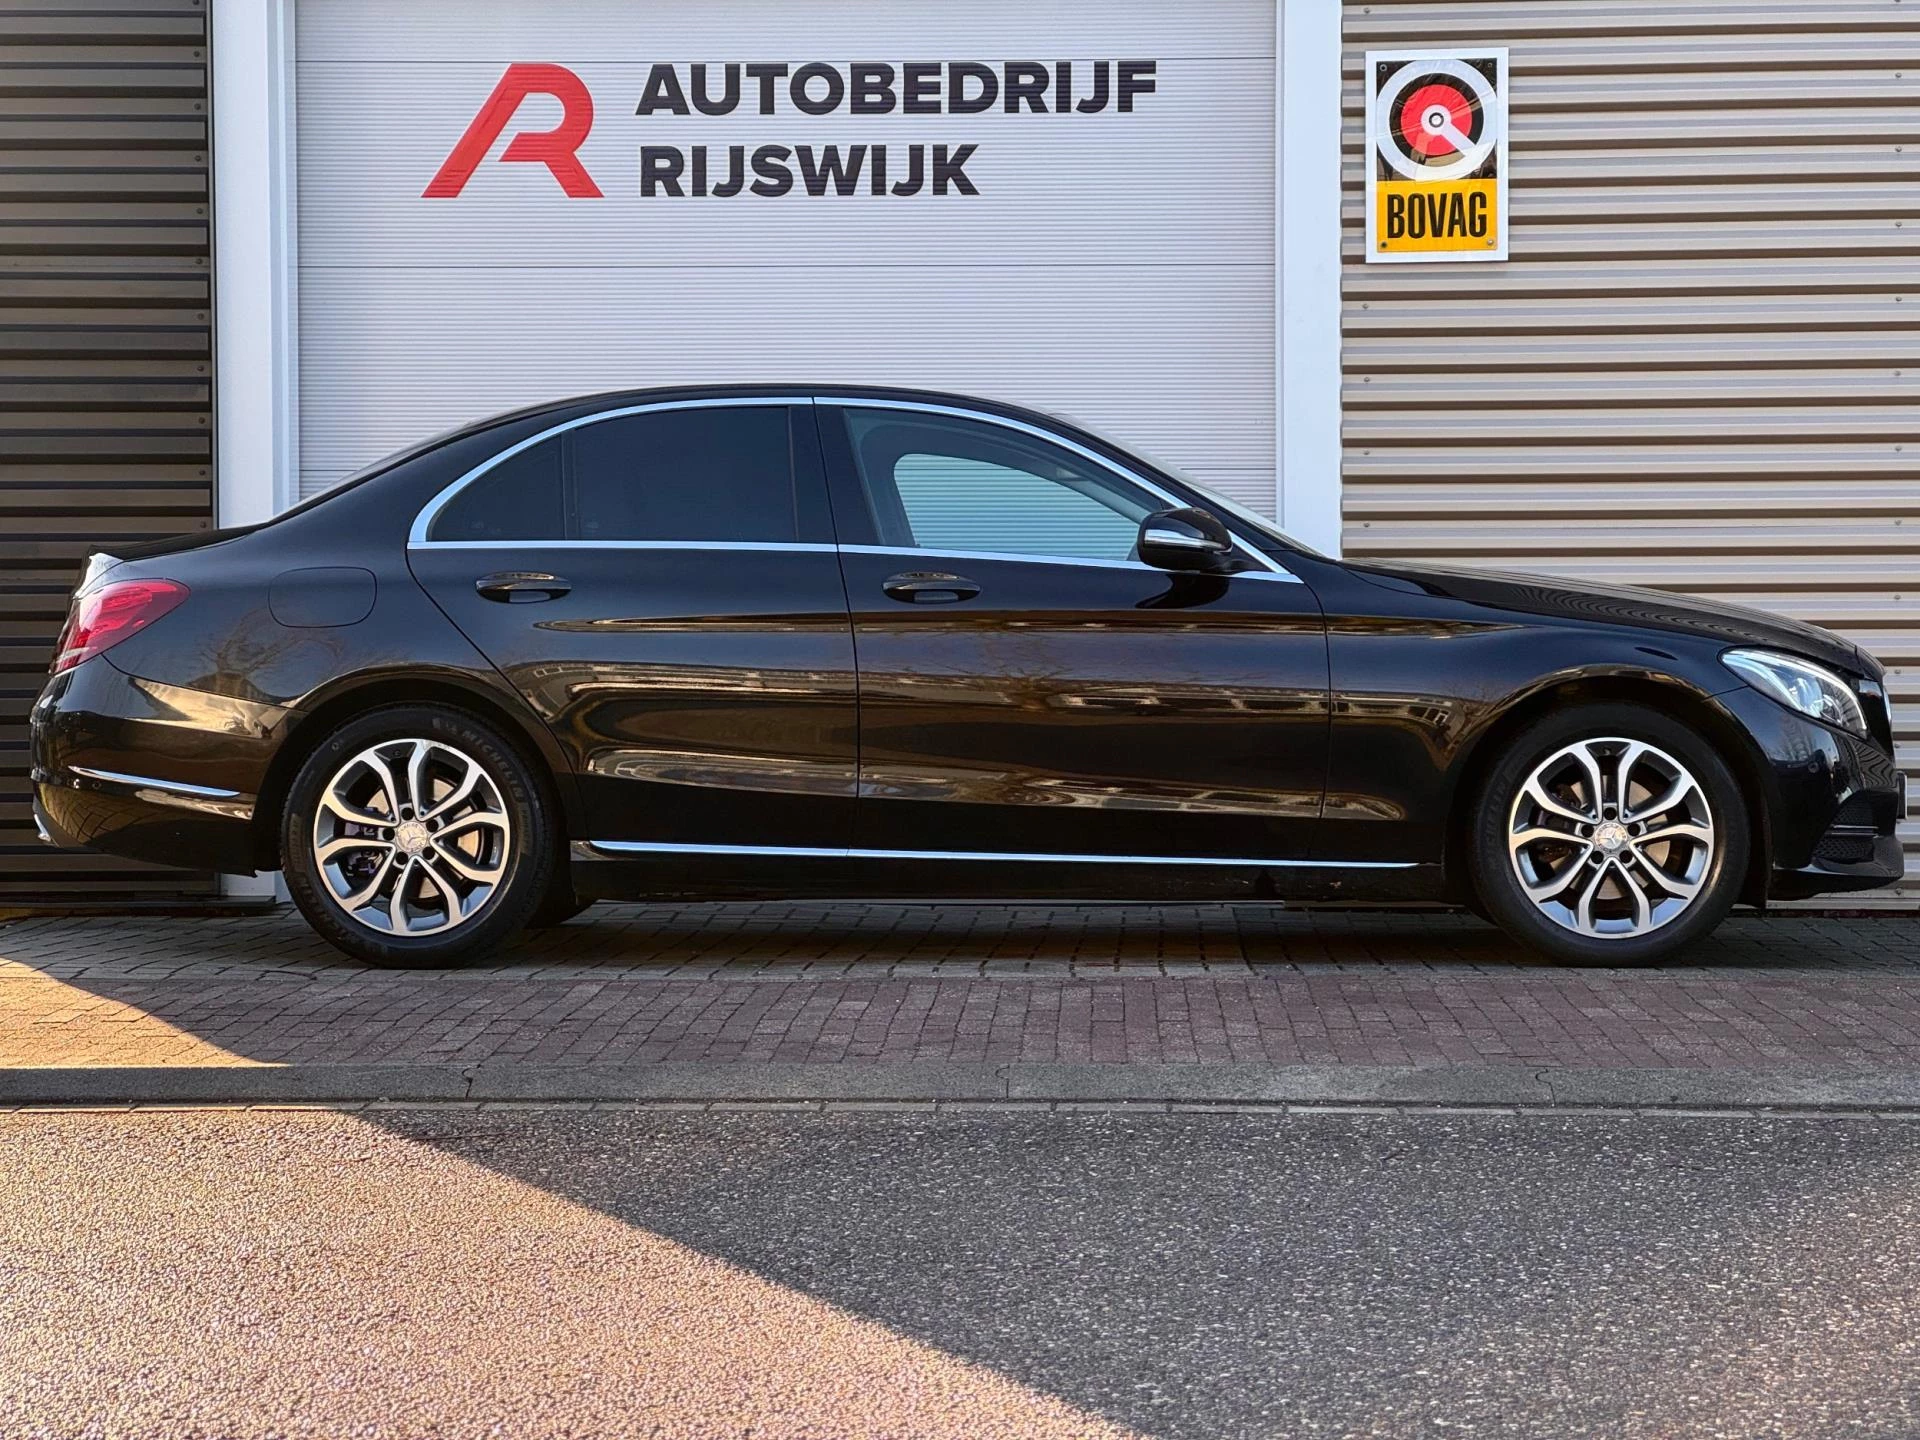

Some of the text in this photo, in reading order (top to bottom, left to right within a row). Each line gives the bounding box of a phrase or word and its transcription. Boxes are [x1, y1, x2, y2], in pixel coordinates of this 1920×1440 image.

[635, 61, 1157, 116] AUTOBEDRIJF
[640, 143, 981, 197] RIJSWIJK
[1386, 191, 1488, 240] BOVAG
